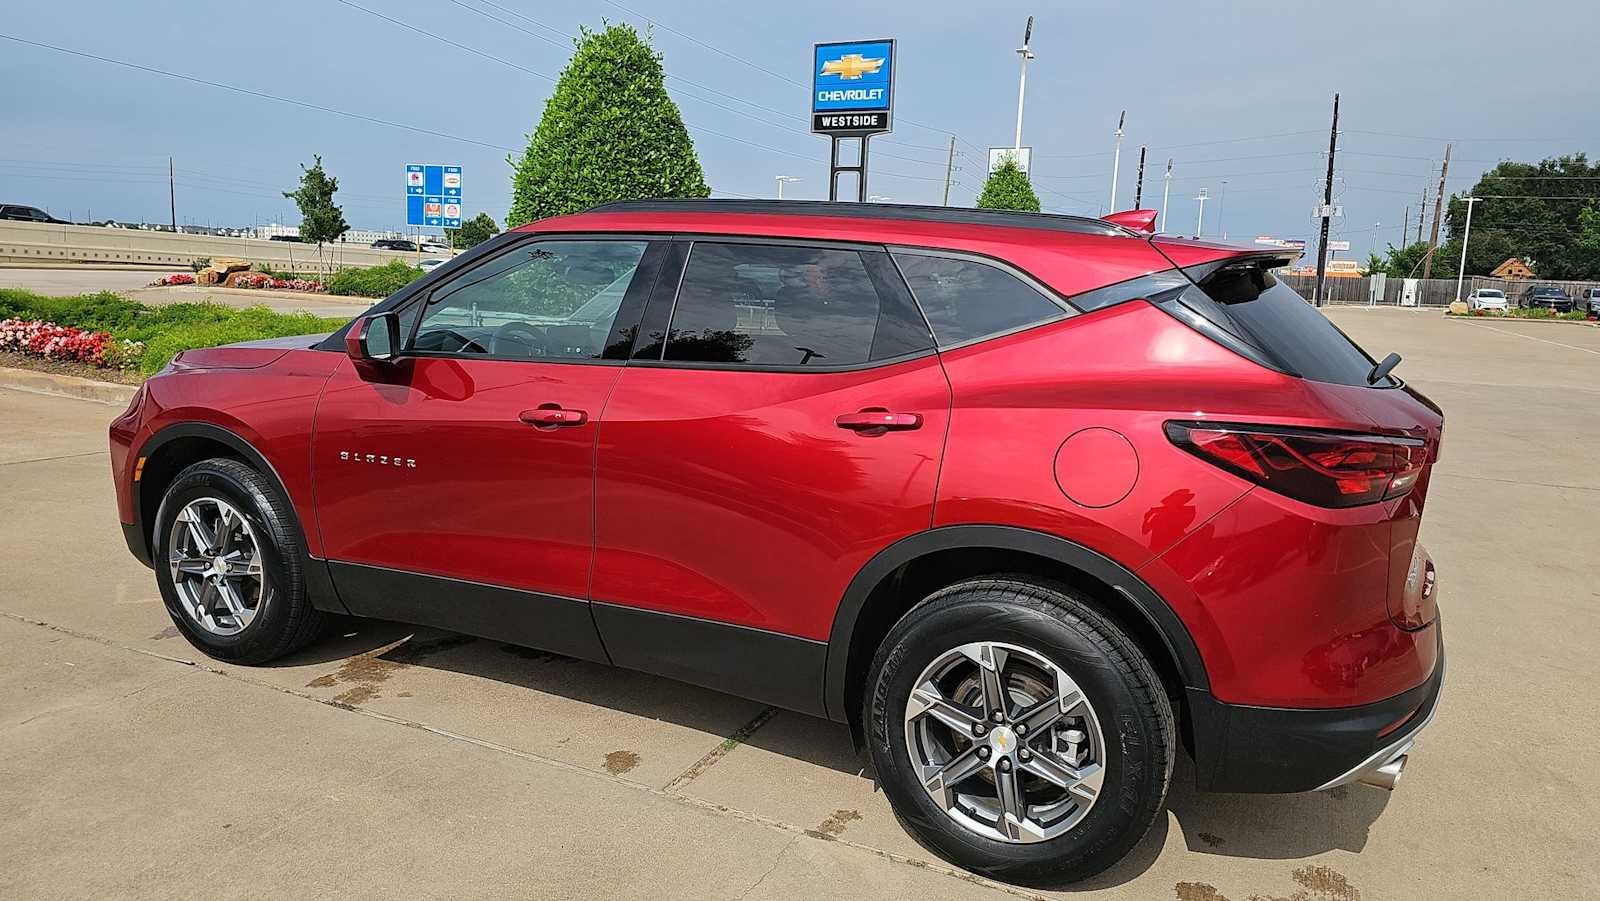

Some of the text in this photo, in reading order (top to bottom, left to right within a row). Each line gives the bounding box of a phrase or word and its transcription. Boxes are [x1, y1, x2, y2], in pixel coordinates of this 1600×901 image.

[818, 88, 884, 102] CHEVROLET
[821, 115, 878, 127] WESTSIDE
[340, 451, 417, 468] BLAZER
